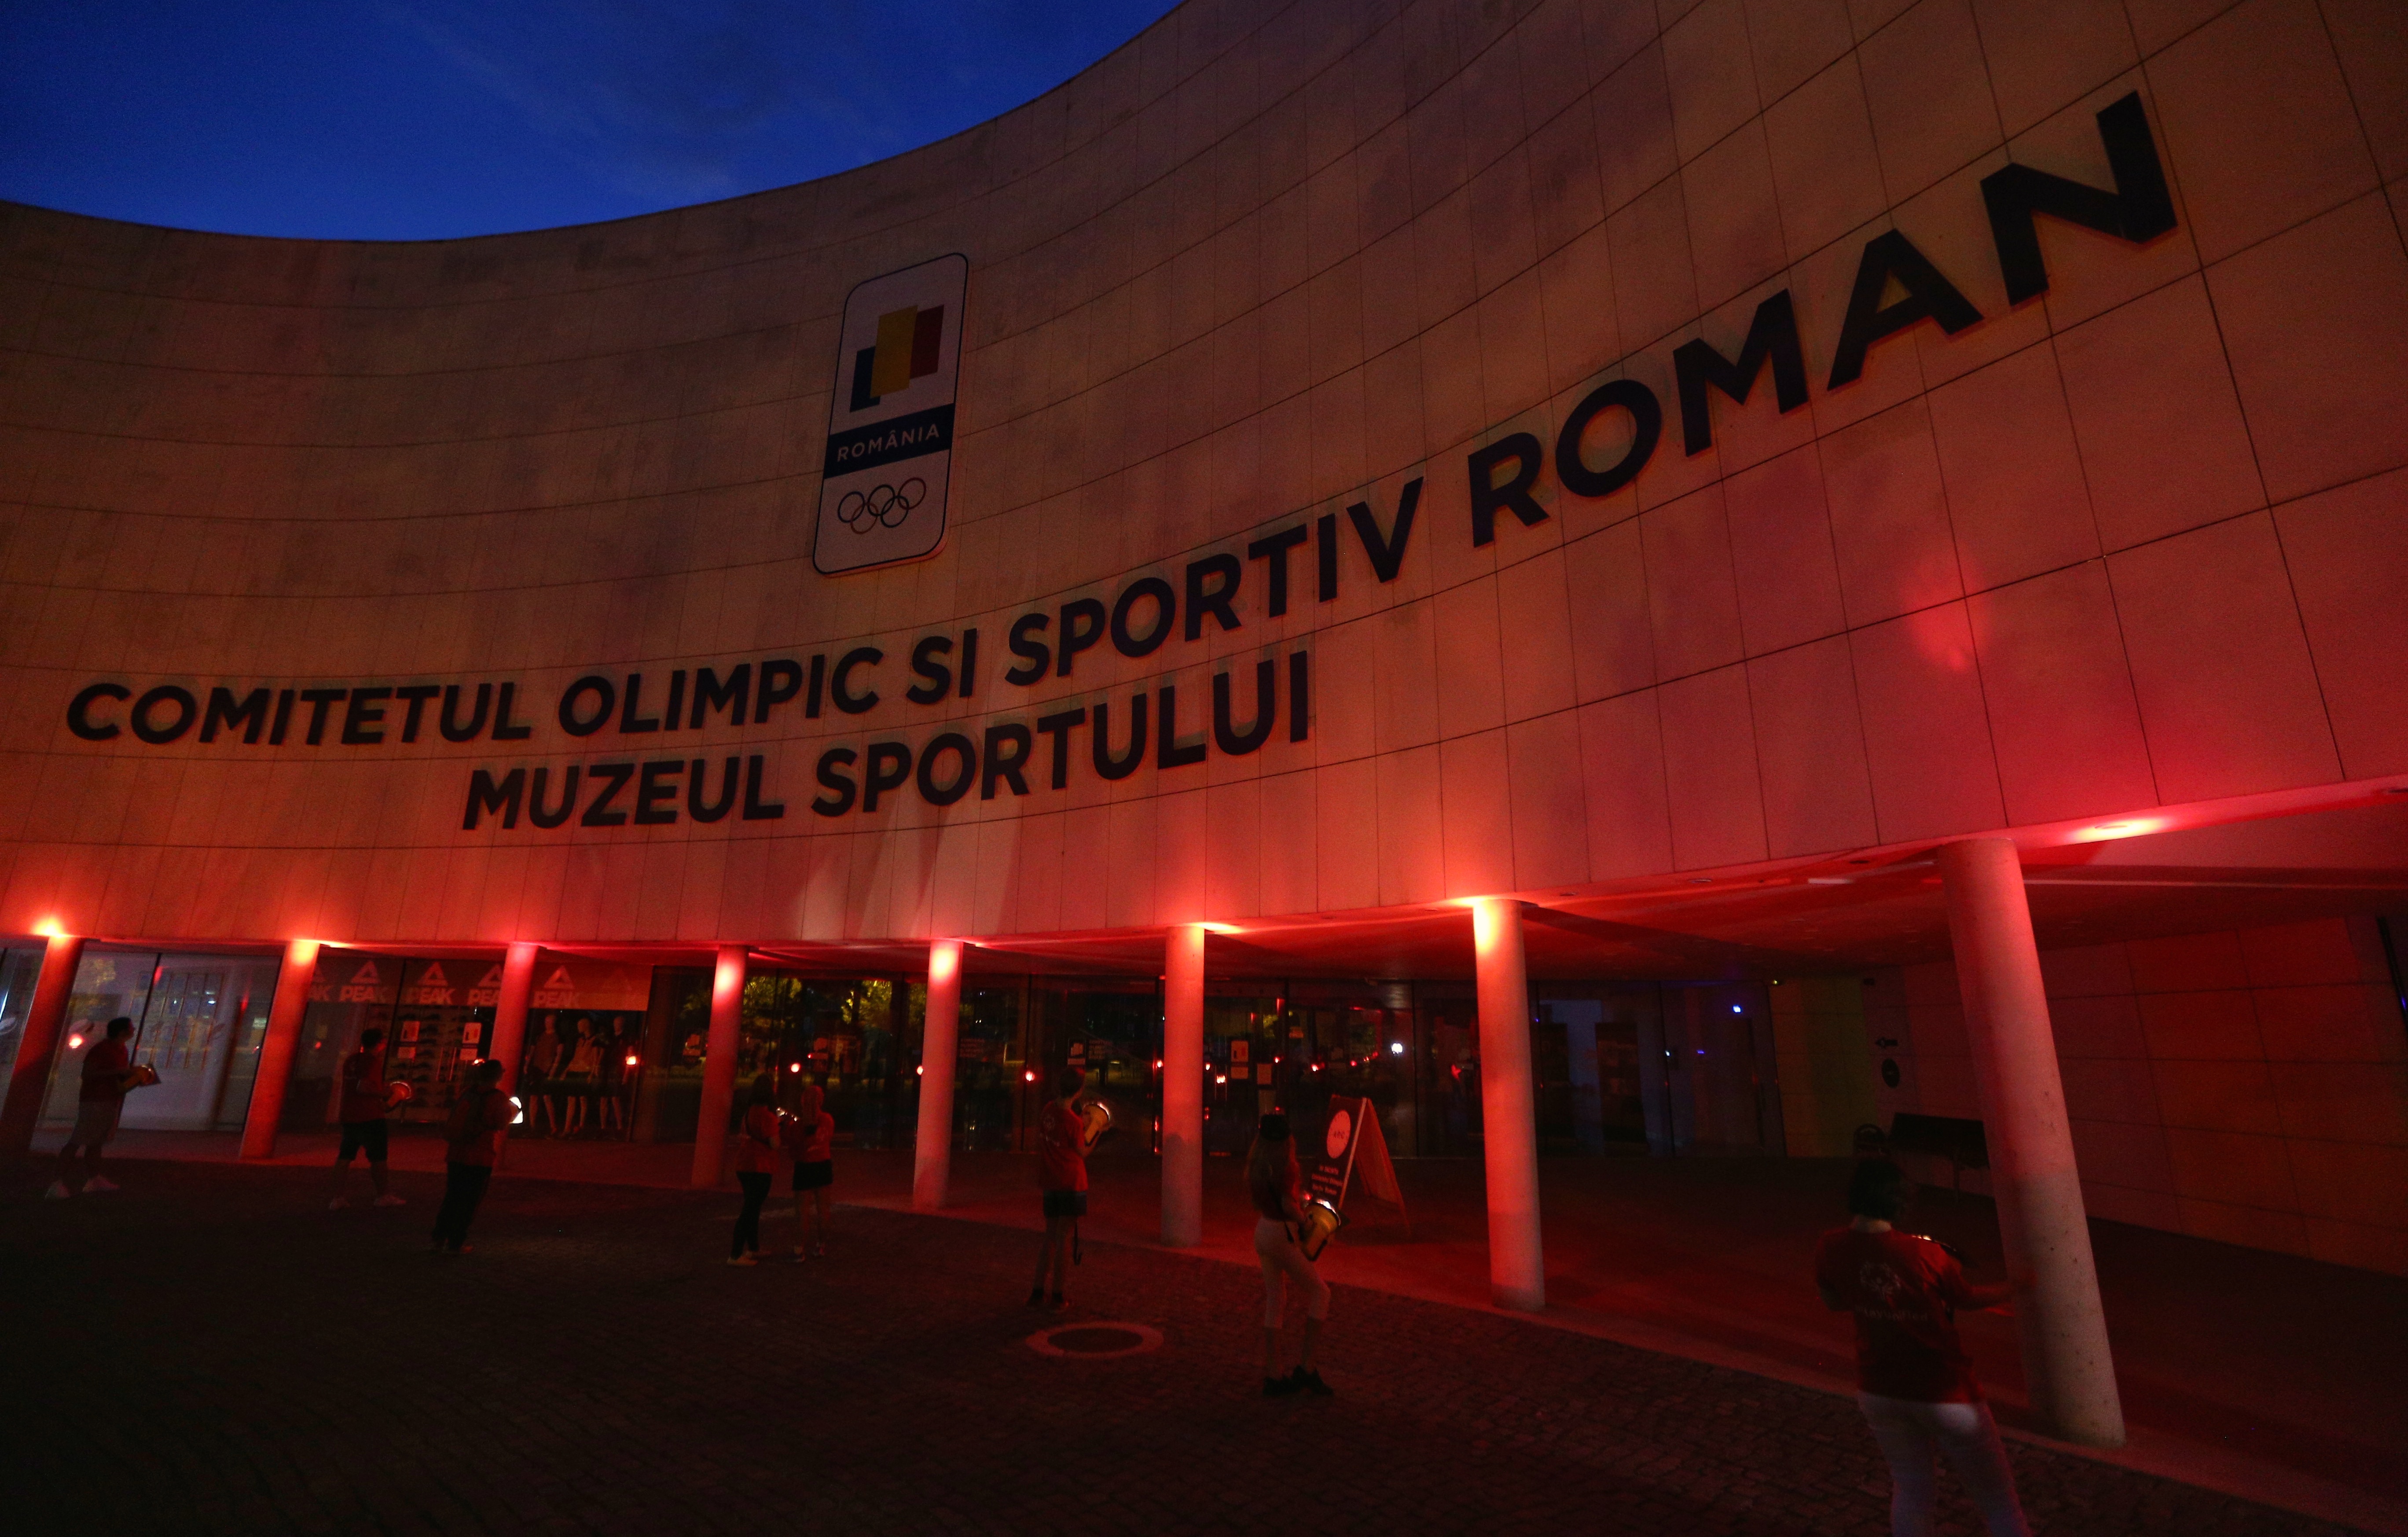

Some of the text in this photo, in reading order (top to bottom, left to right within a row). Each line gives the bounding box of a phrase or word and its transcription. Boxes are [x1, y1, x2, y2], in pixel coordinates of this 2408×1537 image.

[67, 91, 2178, 746] COMITETUL OLIMPIC SI SPORTIV ROMAN
[836, 423, 940, 462] ROMÂNIA
[463, 651, 1308, 830] MUZEUL SPORTULUI
[466, 989, 501, 1007] PEA
